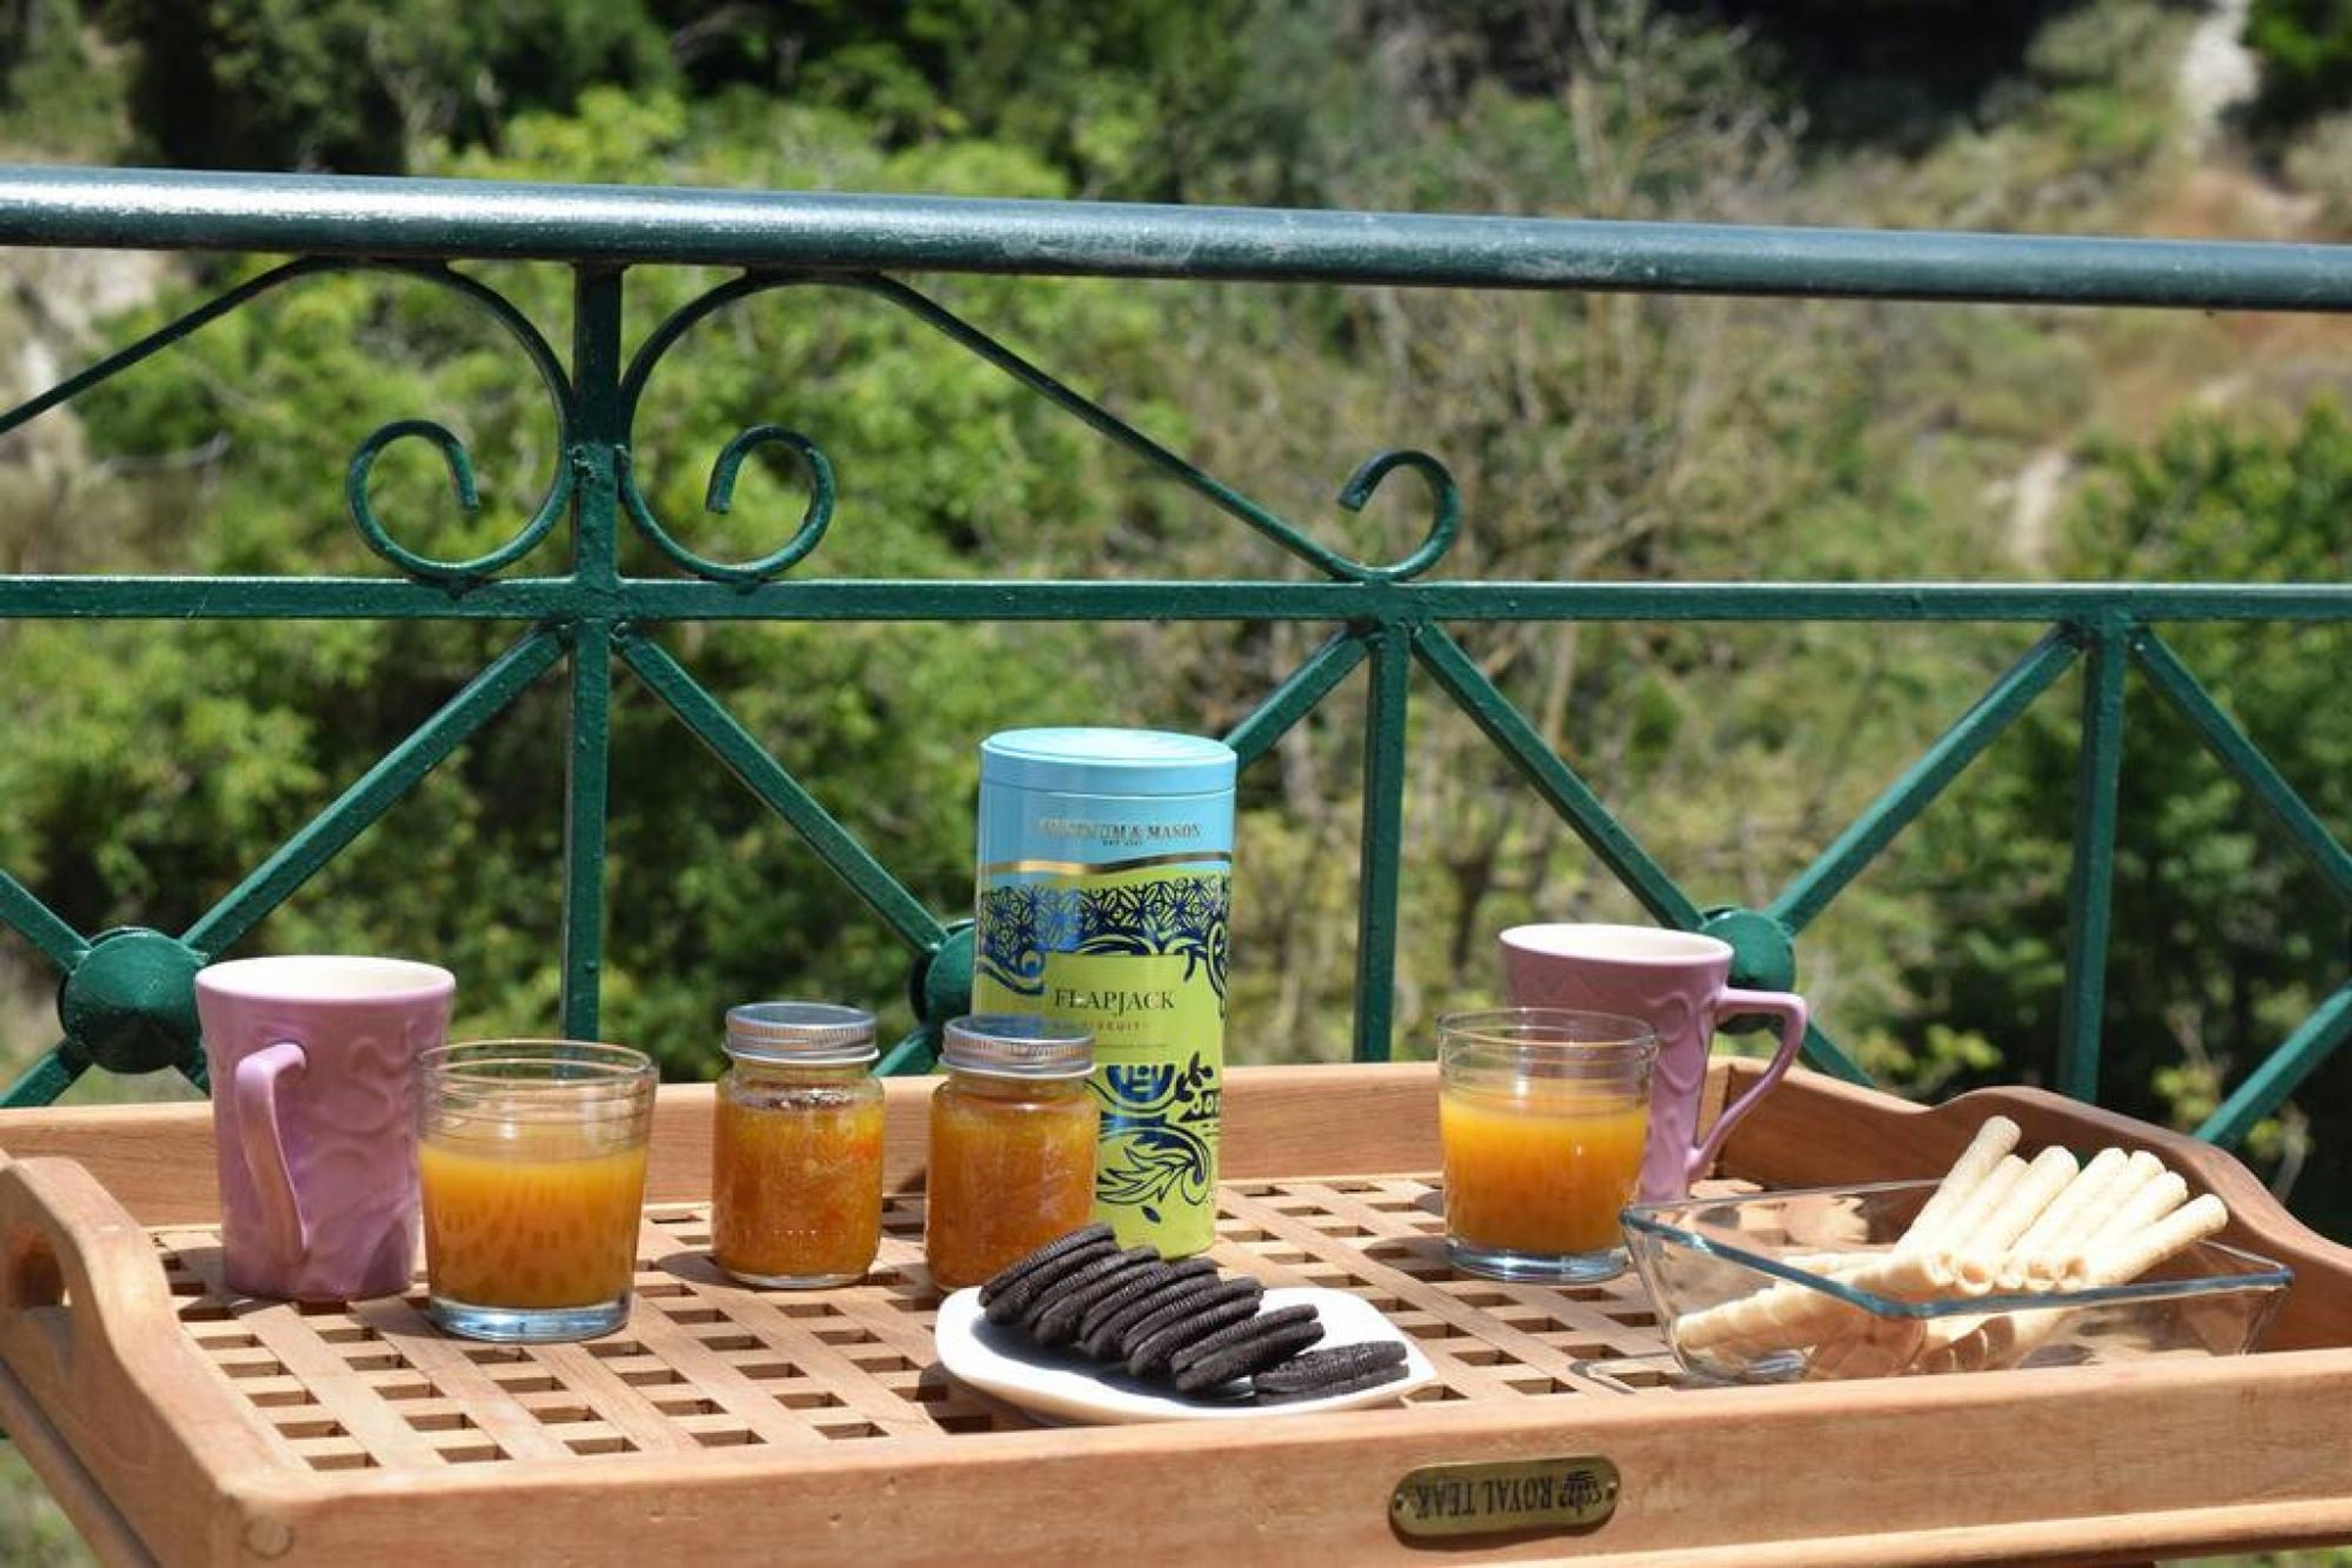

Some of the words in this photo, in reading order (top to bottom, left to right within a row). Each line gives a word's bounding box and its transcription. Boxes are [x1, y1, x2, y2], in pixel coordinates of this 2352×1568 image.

[1146, 823, 1200, 840] MASON
[1054, 989, 1175, 1015] FLAPJACK
[1414, 1481, 1476, 1519] TEAK
[1483, 1475, 1553, 1515] ROYAL
